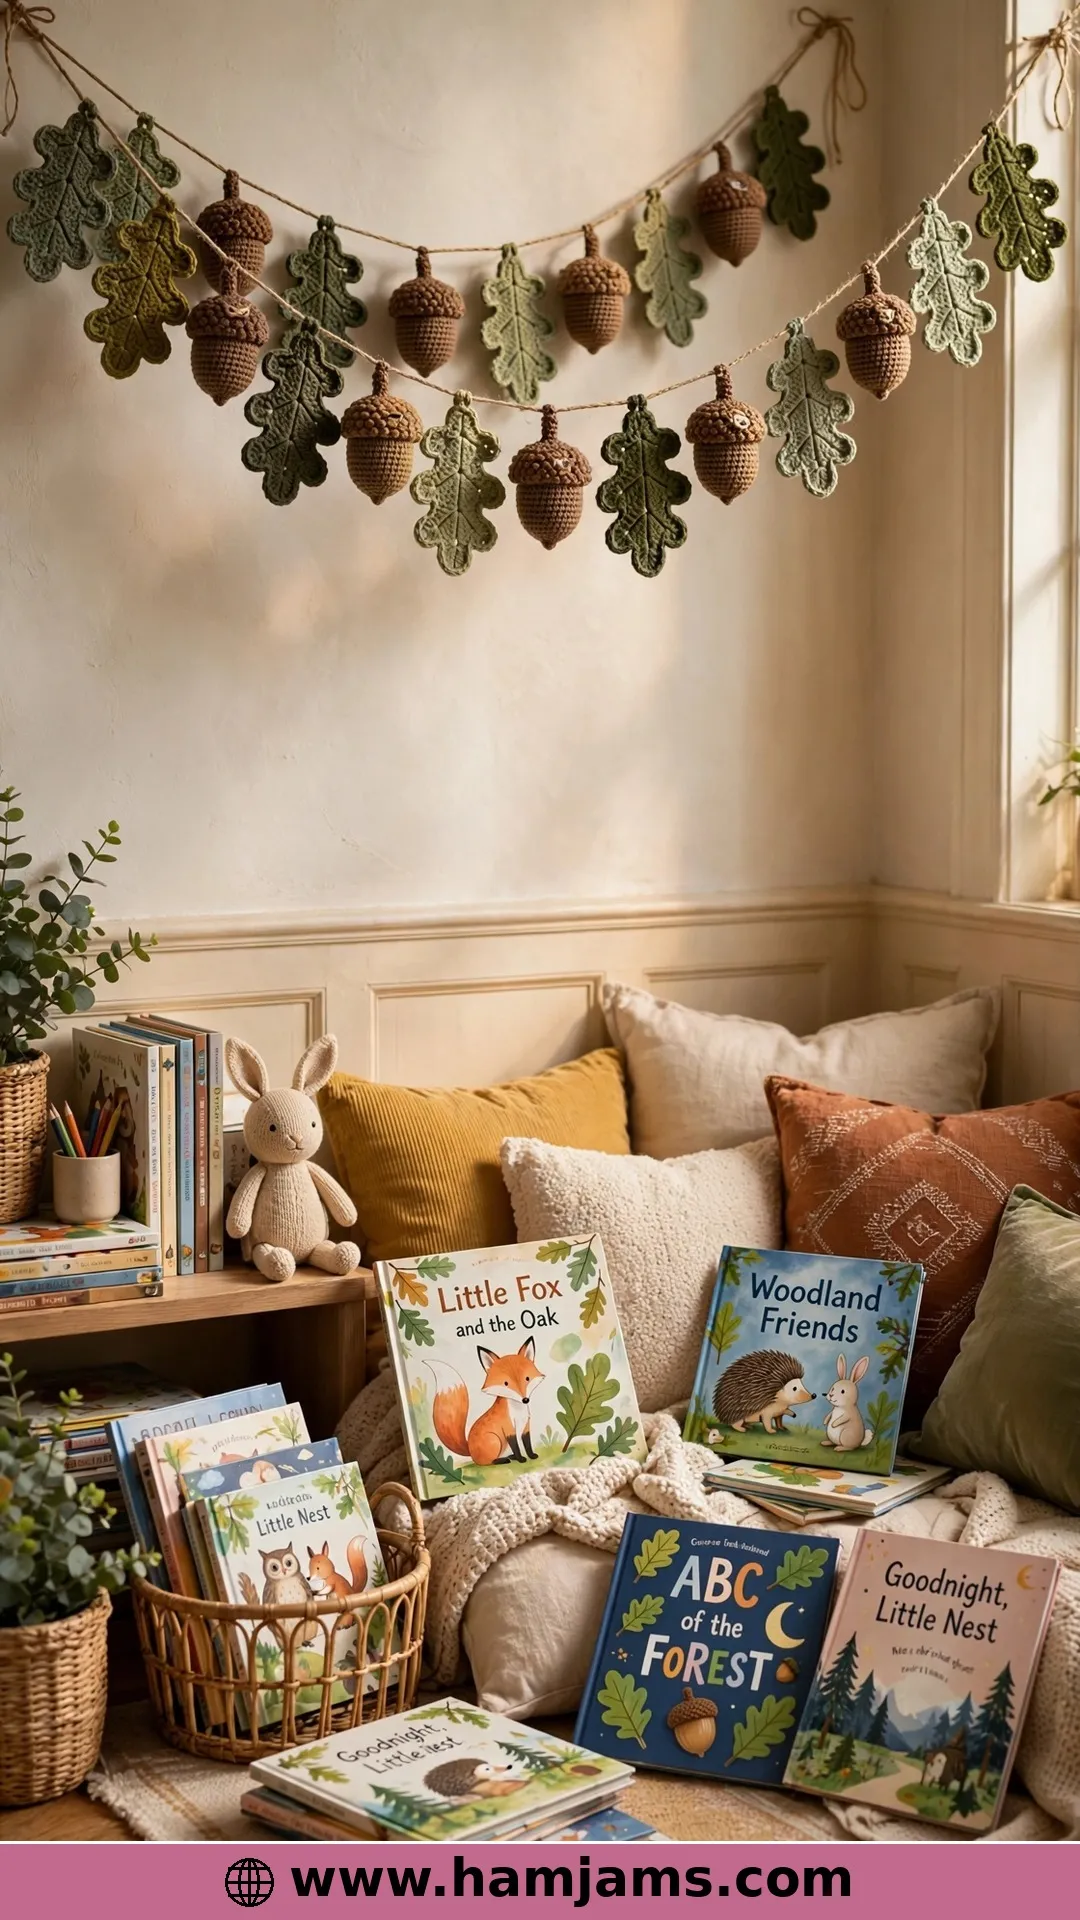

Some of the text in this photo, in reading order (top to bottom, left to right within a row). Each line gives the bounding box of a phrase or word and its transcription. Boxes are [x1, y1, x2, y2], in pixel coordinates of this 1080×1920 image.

[438, 1275, 563, 1314] Little Fox
[751, 1272, 883, 1312] Woodland
[456, 1306, 559, 1338] and the Oak
[760, 1306, 859, 1343] Friends
[256, 1505, 331, 1537] Little Nest
[670, 1555, 763, 1609] ABC
[885, 1561, 1008, 1611] Goodnight,
[681, 1610, 743, 1638] of the
[875, 1595, 998, 1644] Little Nest
[336, 1723, 448, 1763] Goodnight,
[363, 1750, 426, 1774] Little
